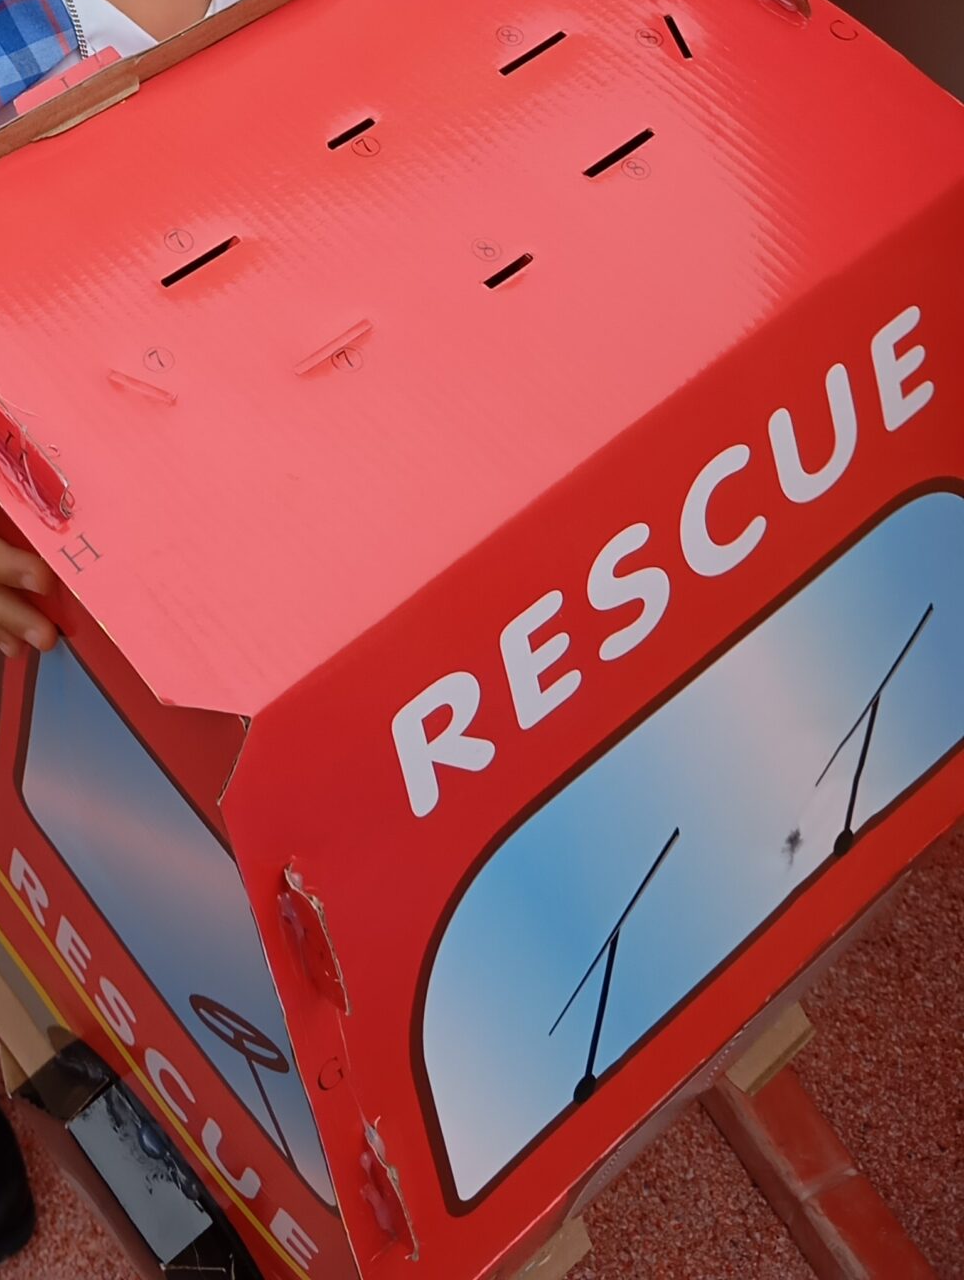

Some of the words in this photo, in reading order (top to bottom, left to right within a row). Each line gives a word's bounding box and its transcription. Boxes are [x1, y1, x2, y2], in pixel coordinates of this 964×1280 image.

[58, 532, 103, 576] H
[390, 305, 935, 818] RESCUE
[8, 847, 319, 1271] RESCUE
